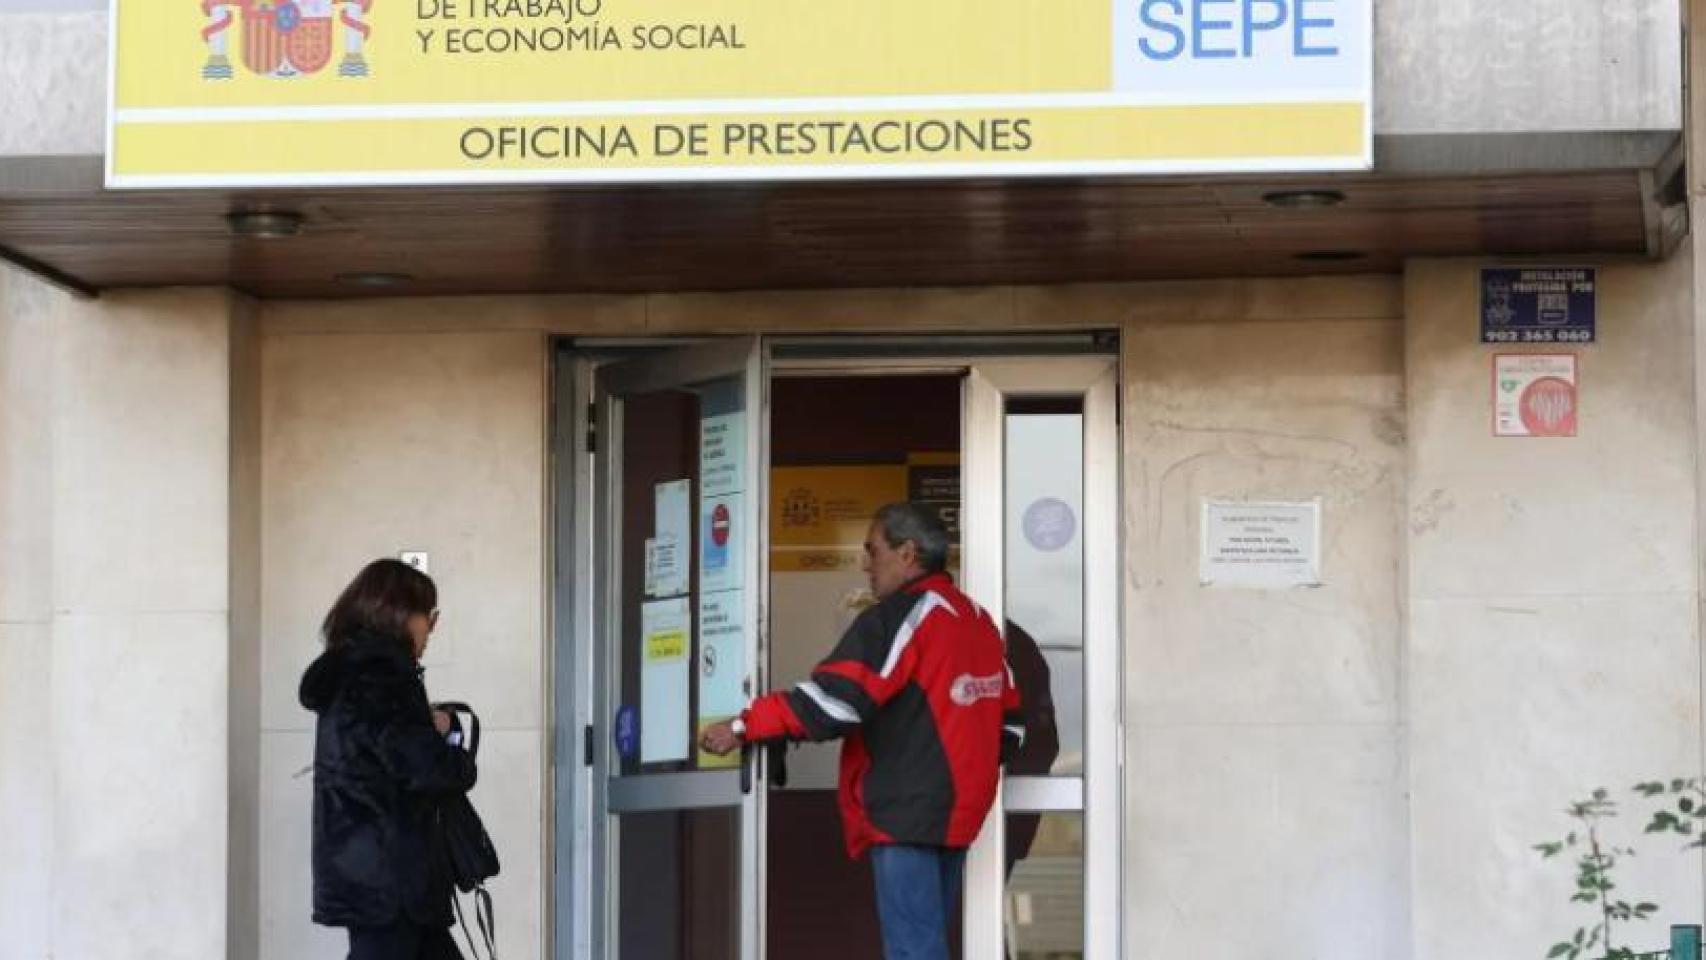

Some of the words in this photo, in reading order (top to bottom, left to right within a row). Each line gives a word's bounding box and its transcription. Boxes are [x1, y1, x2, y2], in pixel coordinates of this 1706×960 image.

[417, 0, 457, 19] DE
[416, 29, 434, 53] Y
[446, 21, 622, 53] ECONOMÍA
[632, 24, 746, 49] SOCIAL
[1138, 0, 1339, 61] SEPE
[459, 125, 638, 159] OFICINA
[654, 123, 709, 156] DE
[723, 118, 1032, 155] PRESTACIONES
